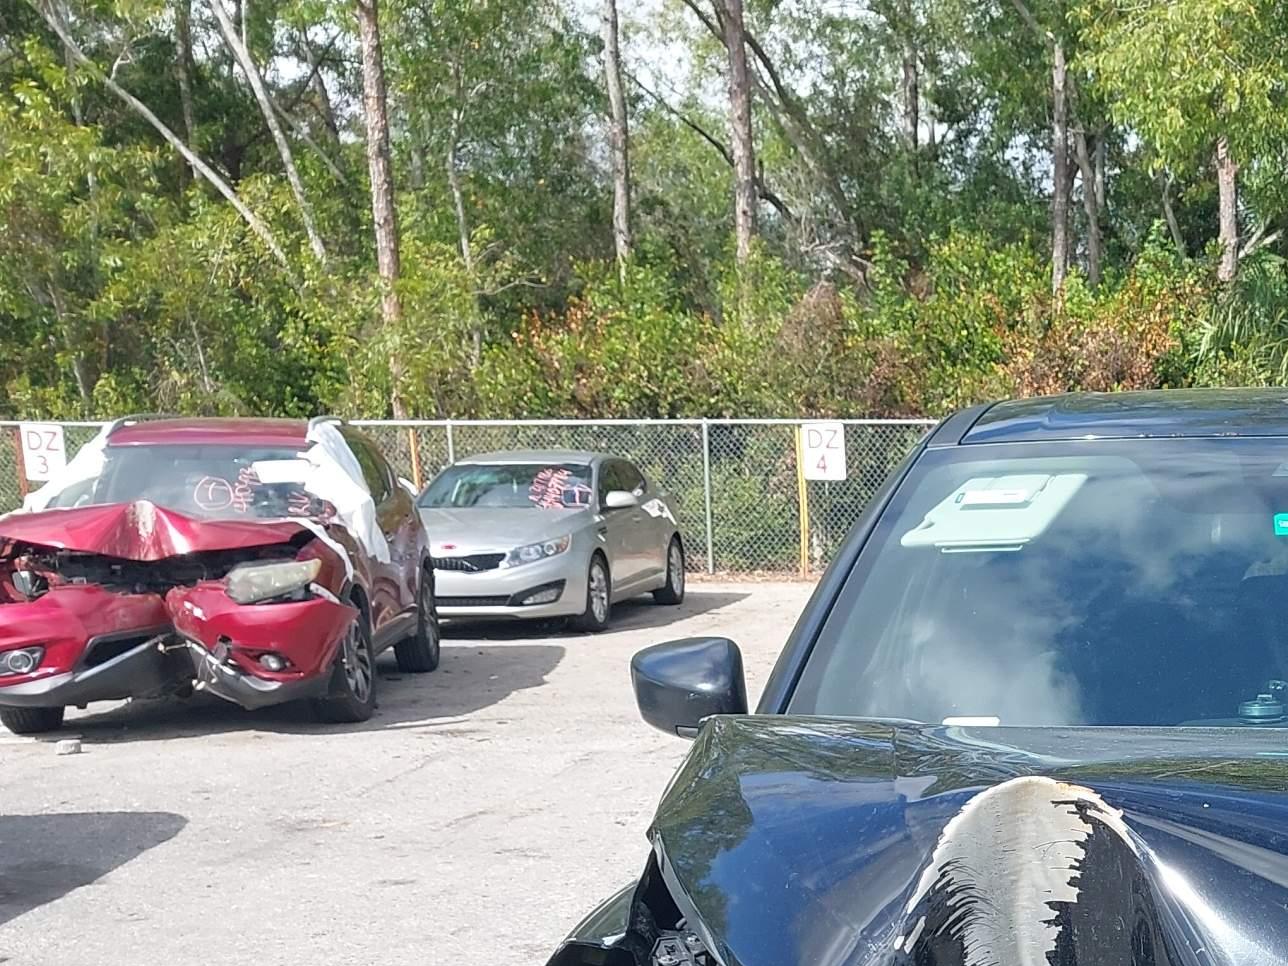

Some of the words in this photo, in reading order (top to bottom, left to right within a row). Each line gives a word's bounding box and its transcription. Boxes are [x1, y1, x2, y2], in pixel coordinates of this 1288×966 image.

[26, 430, 60, 451] DZ
[807, 429, 841, 449] DZ
[36, 455, 49, 474] 3
[816, 453, 827, 474] 4
